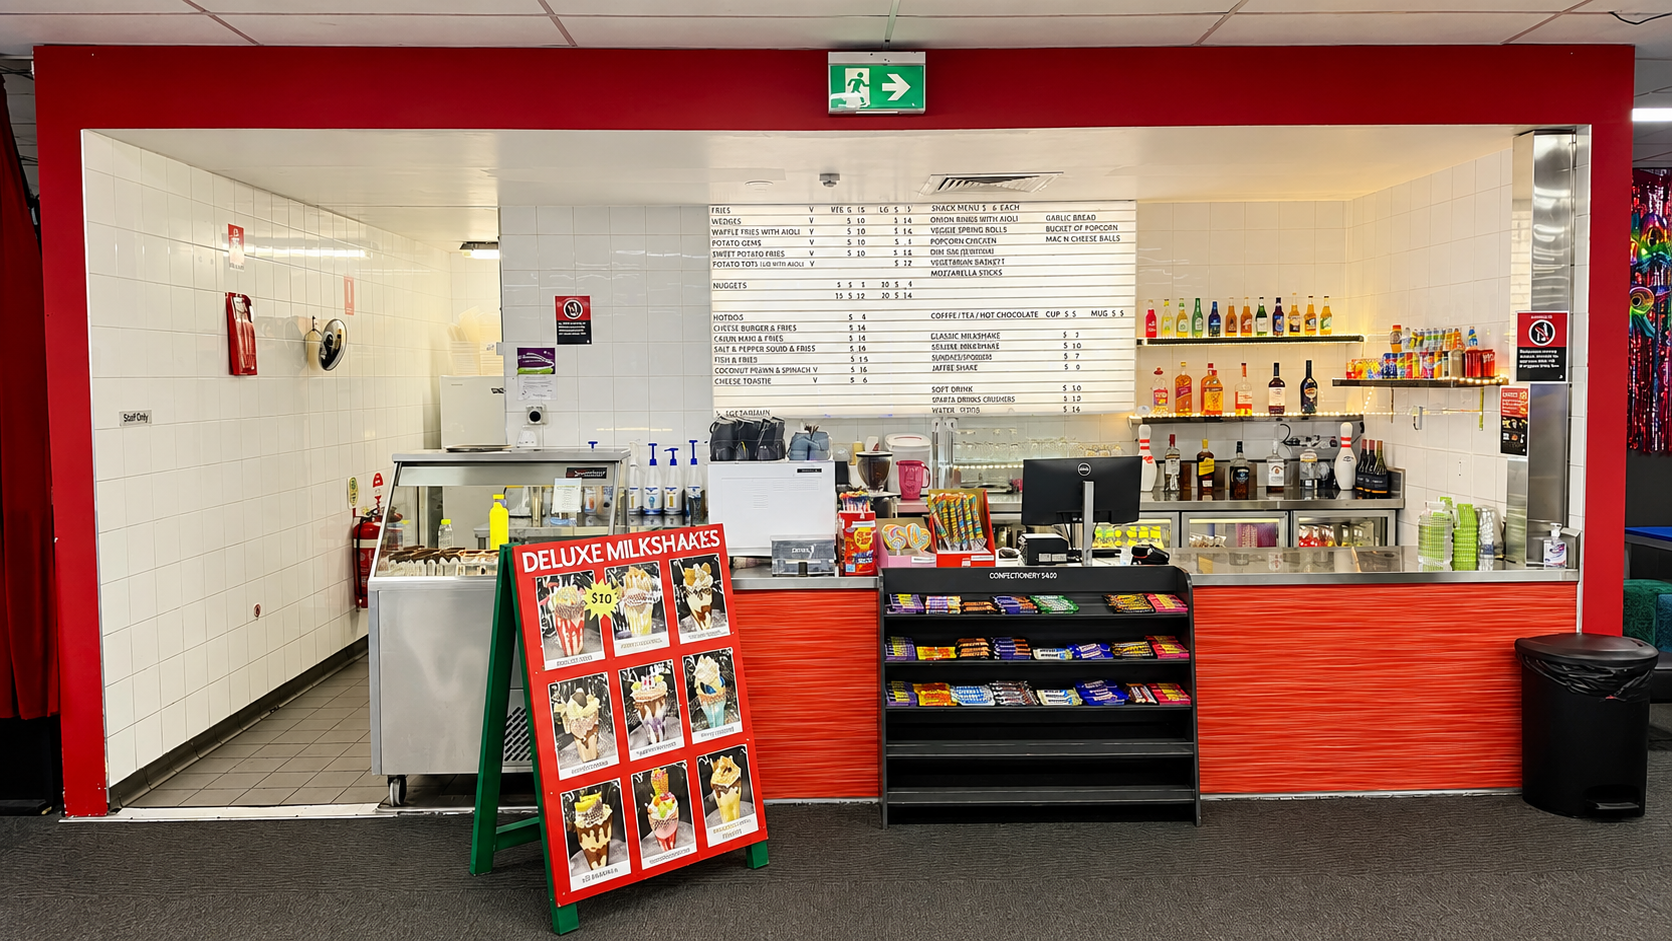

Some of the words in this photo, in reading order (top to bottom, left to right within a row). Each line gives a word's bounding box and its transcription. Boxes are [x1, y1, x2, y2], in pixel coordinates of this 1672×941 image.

[522, 545, 601, 574] DELUXE
[606, 530, 721, 562] MILKSHAKES
[591, 592, 612, 604] $10
